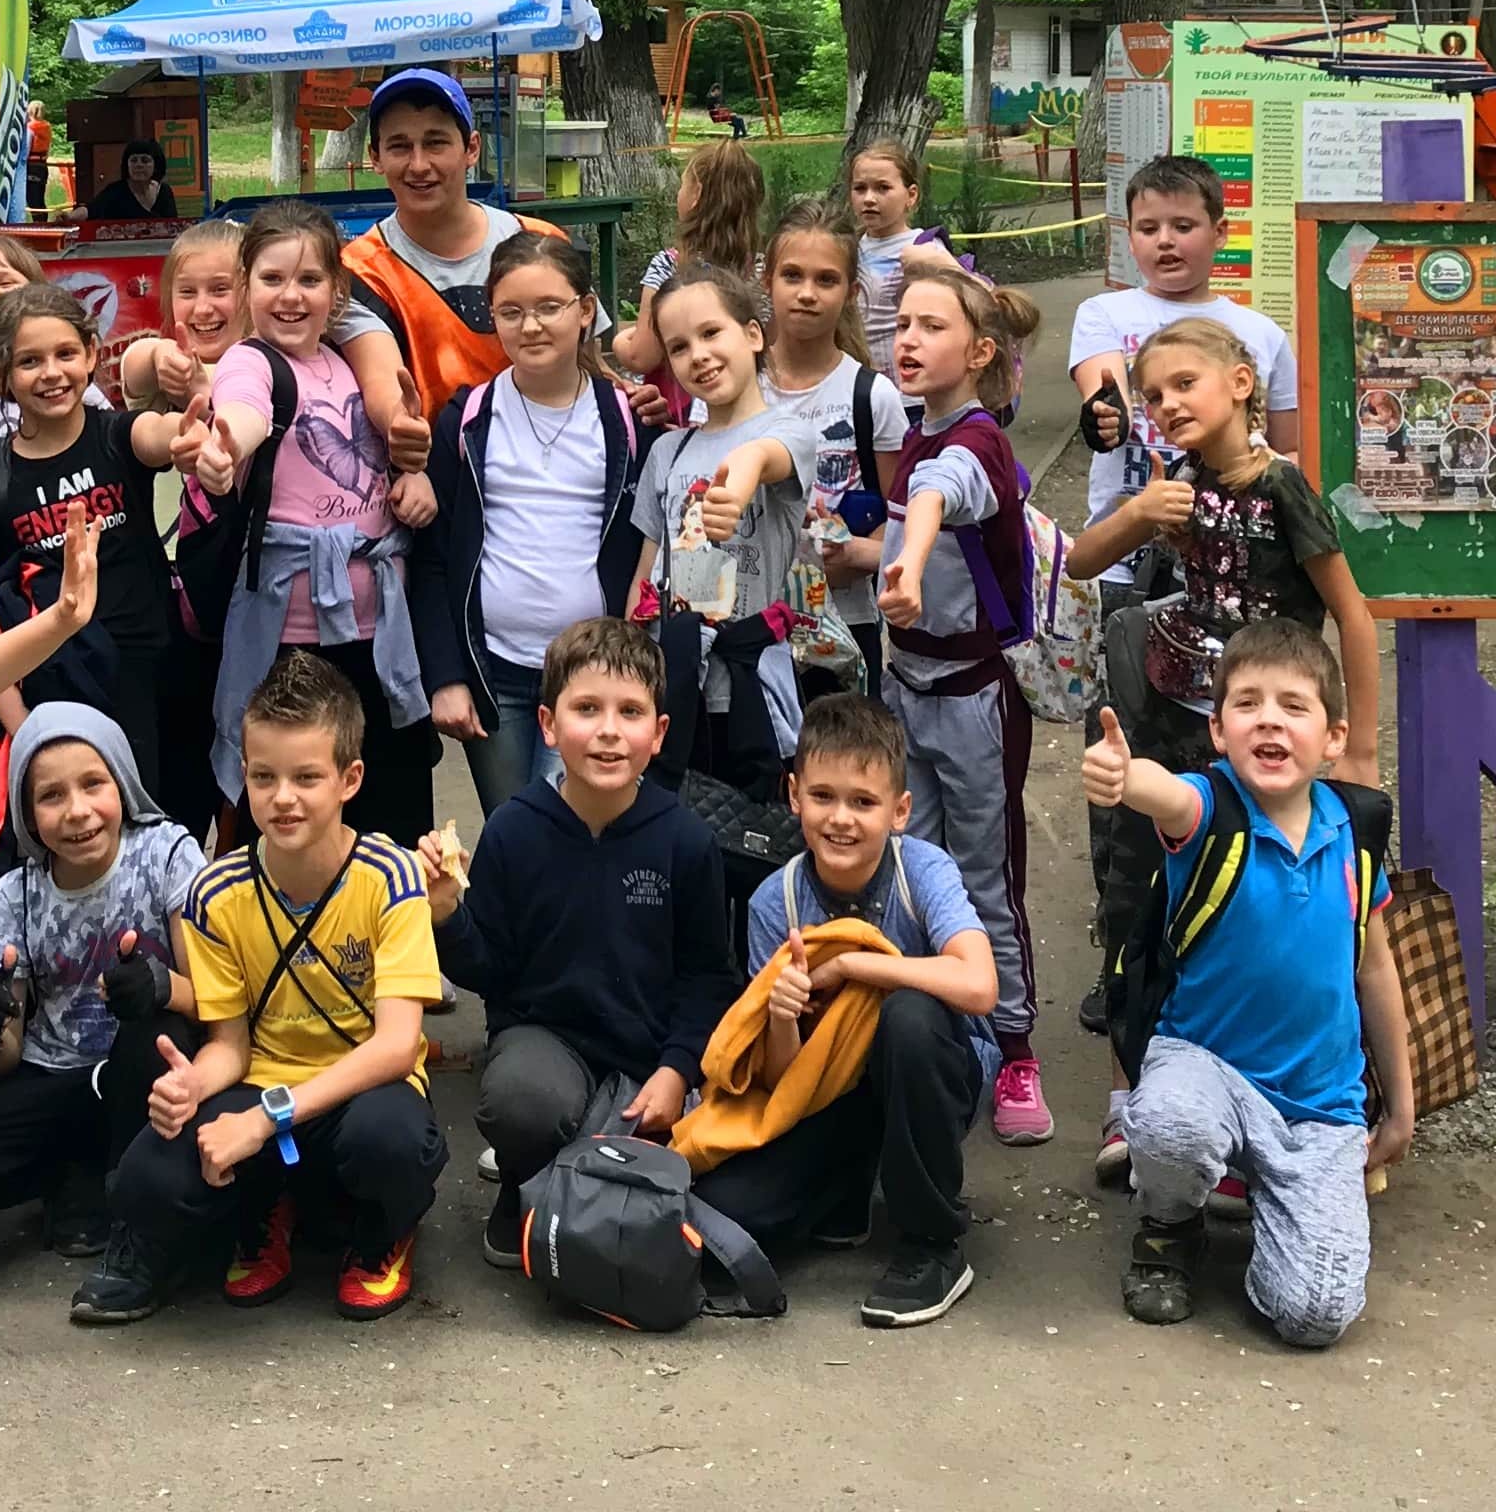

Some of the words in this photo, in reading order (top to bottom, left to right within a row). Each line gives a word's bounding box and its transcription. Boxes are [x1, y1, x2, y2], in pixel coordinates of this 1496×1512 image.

[373, 12, 473, 33] МОРОЗИВО
[168, 27, 268, 47] МОРОЗИВО
[1195, 69, 1232, 81] ТВОЙ
[1235, 71, 1308, 82] РЕЗУЛЬТАТ
[1038, 89, 1088, 116] МО
[35, 485, 47, 505] I
[58, 467, 96, 500] AM
[25, 533, 68, 552] DANC
